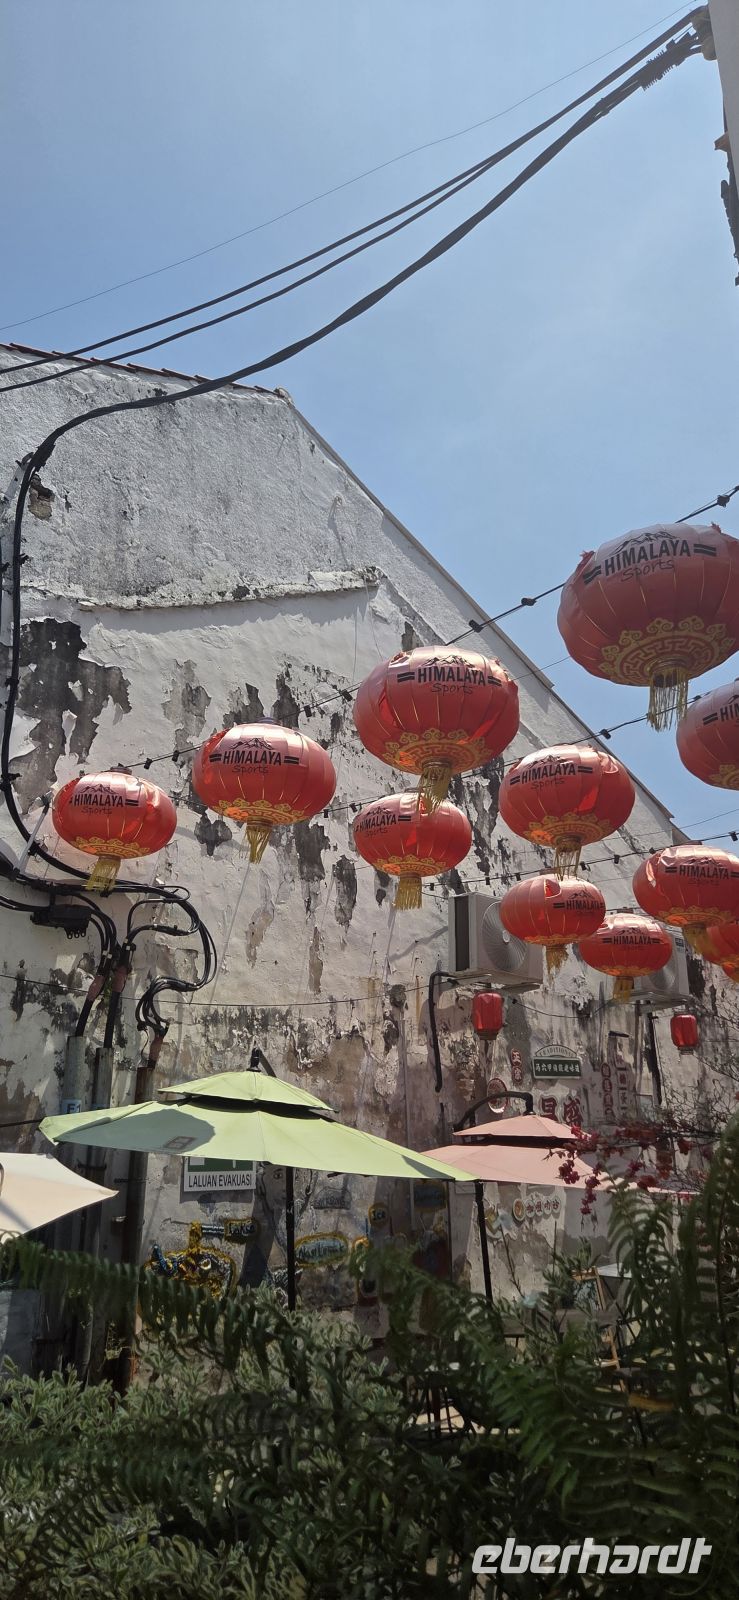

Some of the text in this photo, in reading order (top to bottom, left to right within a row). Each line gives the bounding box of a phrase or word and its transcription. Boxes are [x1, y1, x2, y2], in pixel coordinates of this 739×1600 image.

[604, 540, 691, 576] HIMALAYA
[621, 560, 674, 582] Sports
[418, 666, 486, 686] HIMALAYA
[431, 683, 473, 696] Sports
[223, 750, 282, 766] HIMALAYA
[232, 765, 269, 775] Sports
[521, 763, 576, 784] HIMALAYA
[531, 777, 565, 790] Sports
[74, 793, 123, 807] HIMALAYA
[81, 806, 112, 815] Sports
[360, 814, 397, 832] HIMALAYA
[680, 864, 729, 879] HIMALAYA
[613, 935, 652, 945] HIMALAYA
[188, 1172, 252, 1188] LALUAN EVAKUASI
